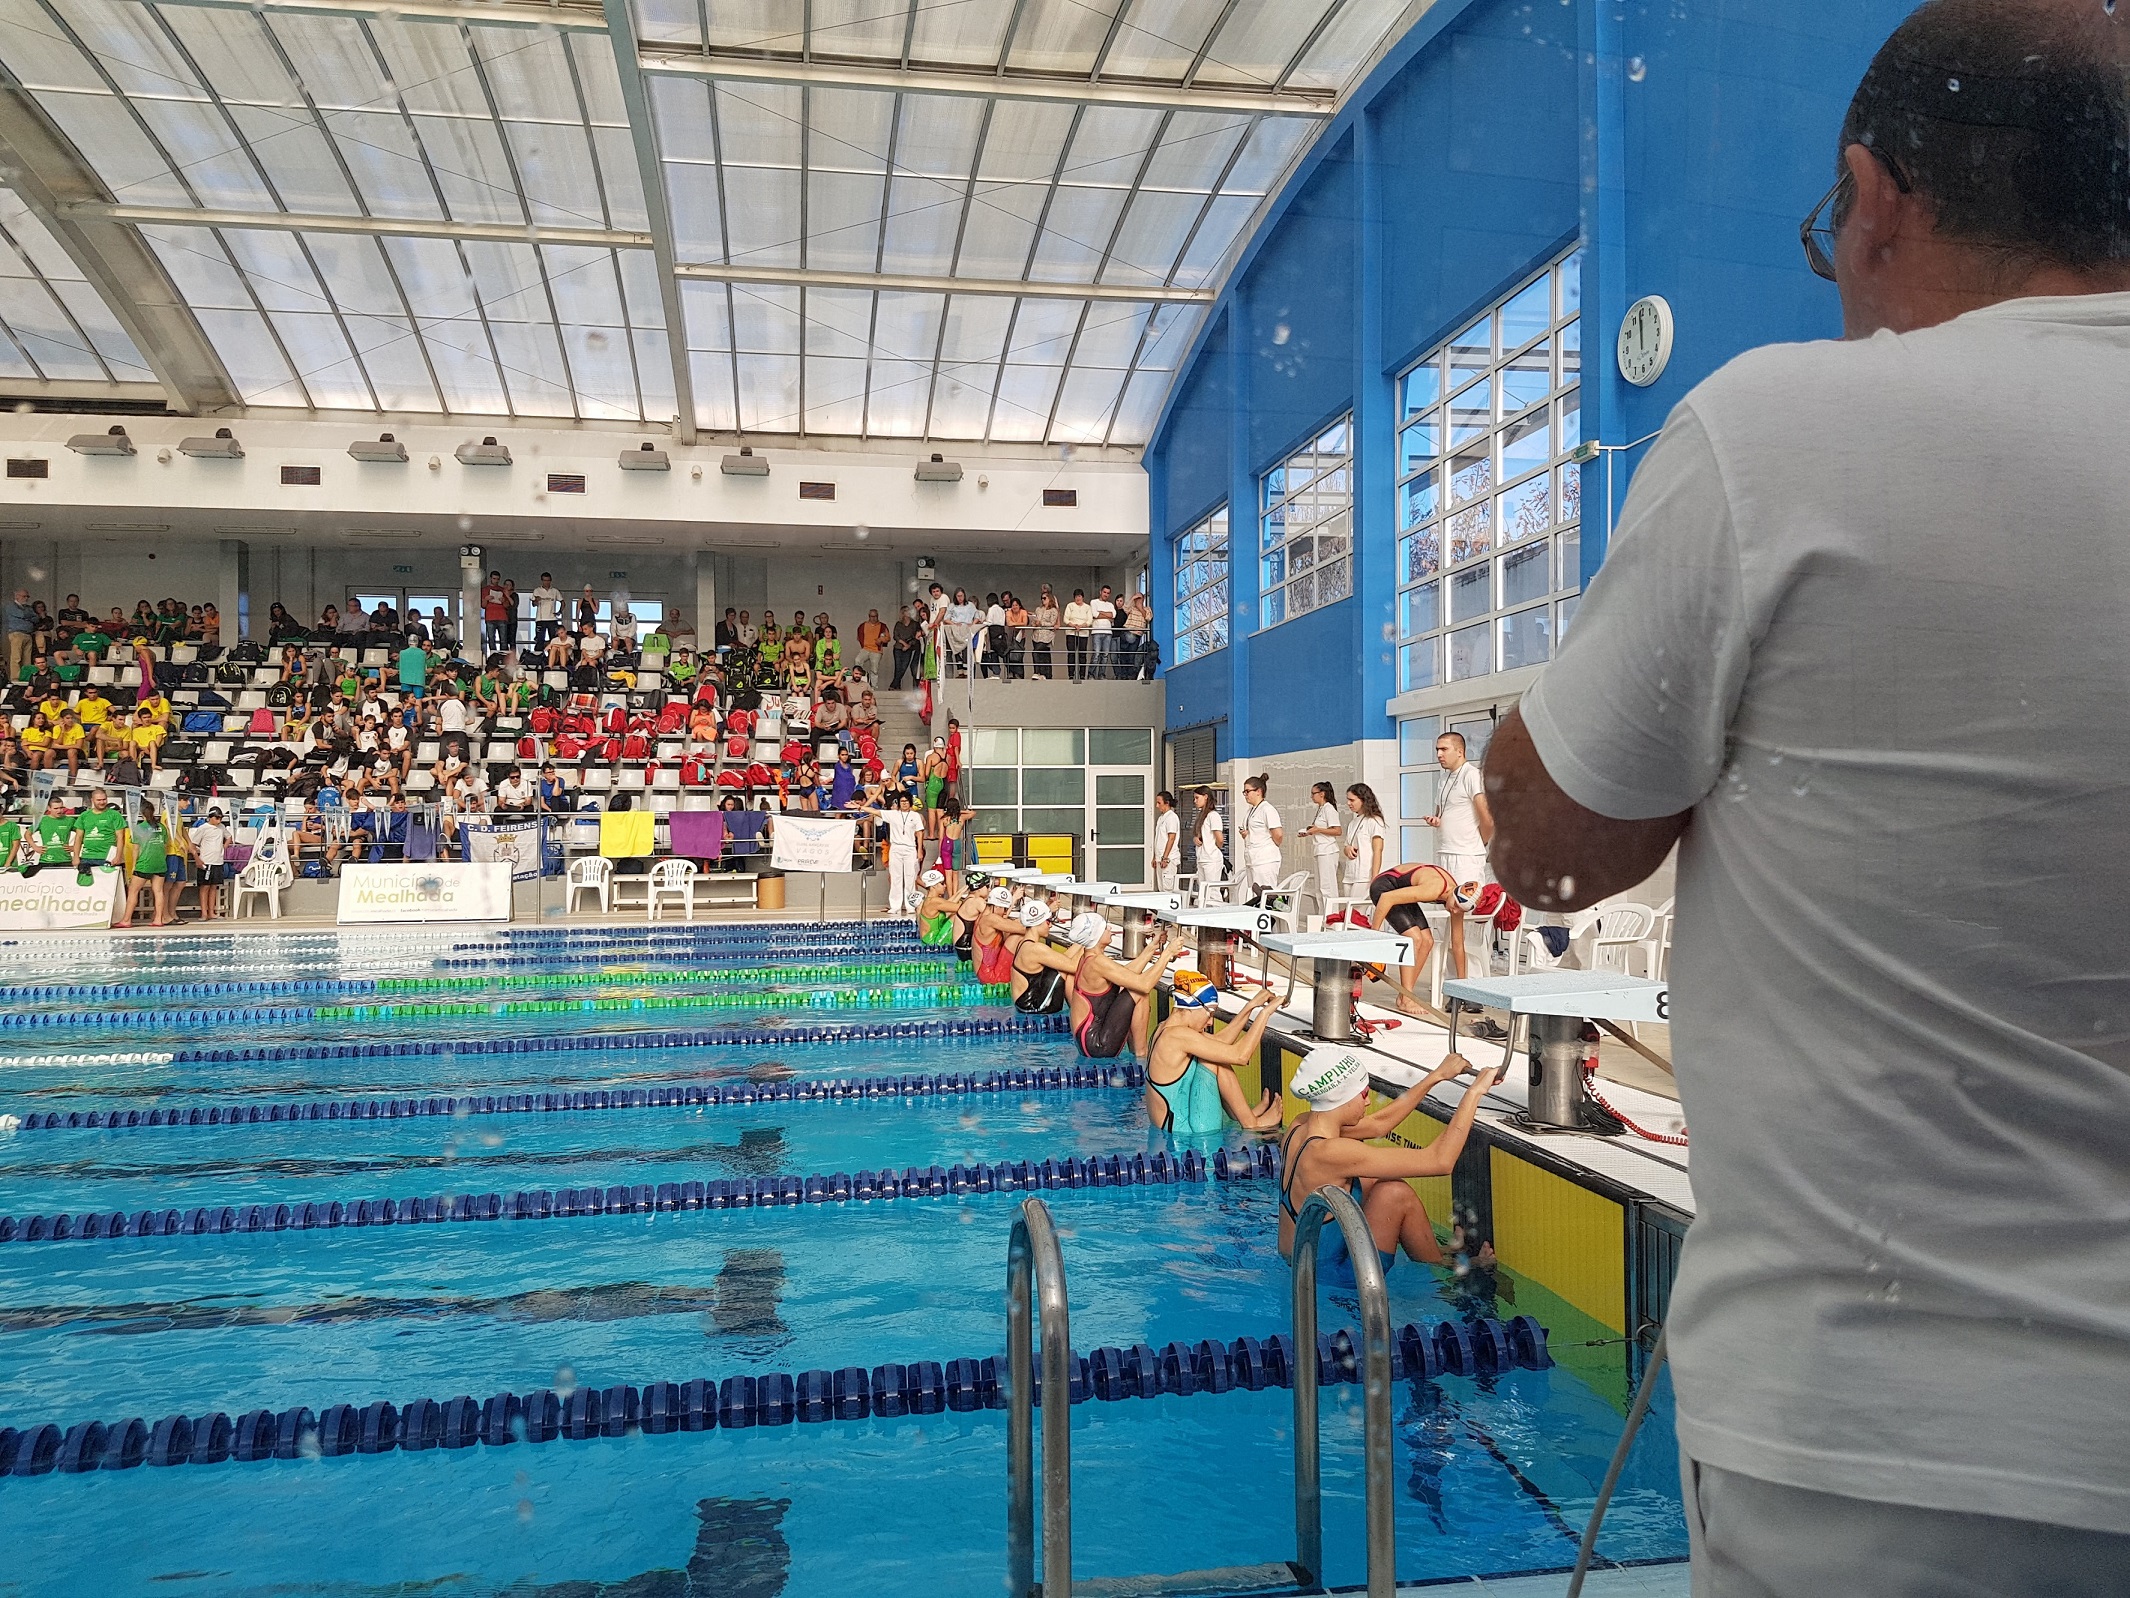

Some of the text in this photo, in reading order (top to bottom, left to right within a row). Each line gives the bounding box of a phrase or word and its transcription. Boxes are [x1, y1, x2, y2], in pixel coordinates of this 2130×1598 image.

[467, 824, 478, 832] C.
[353, 873, 460, 890] Município de
[513, 871, 538, 881] atação
[357, 888, 454, 904] Mealhada
[1110, 886, 1117, 894] 4
[1170, 899, 1179, 909] 5
[1257, 913, 1269, 929] 6
[1395, 943, 1409, 962] 7
[1656, 991, 1669, 1019] 8
[1298, 1055, 1356, 1096] CAMPINHO
